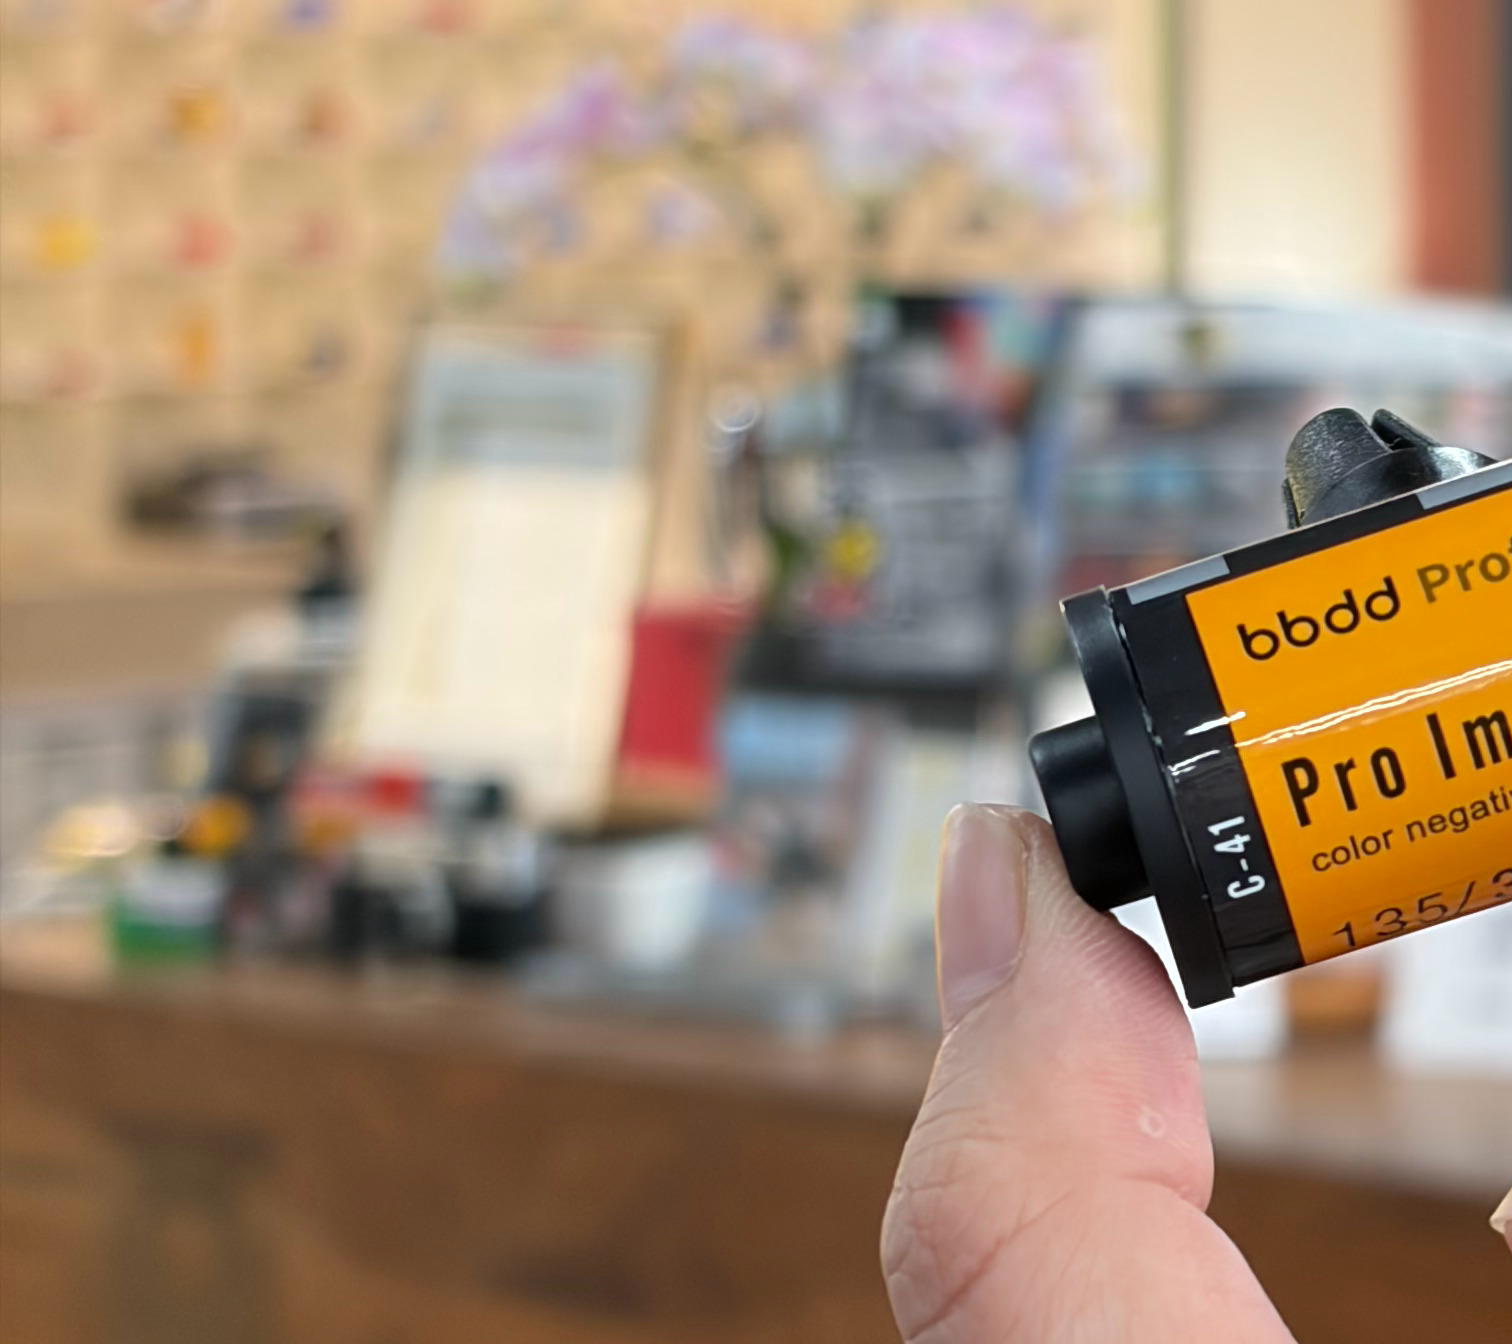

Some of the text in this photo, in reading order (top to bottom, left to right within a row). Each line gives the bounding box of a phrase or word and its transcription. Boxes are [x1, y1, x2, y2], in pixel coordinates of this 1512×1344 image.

[1236, 576, 1402, 661] bbdd
[1282, 747, 1406, 827] Pro
[1208, 815, 1266, 899] C-41
[1311, 827, 1393, 874] color
